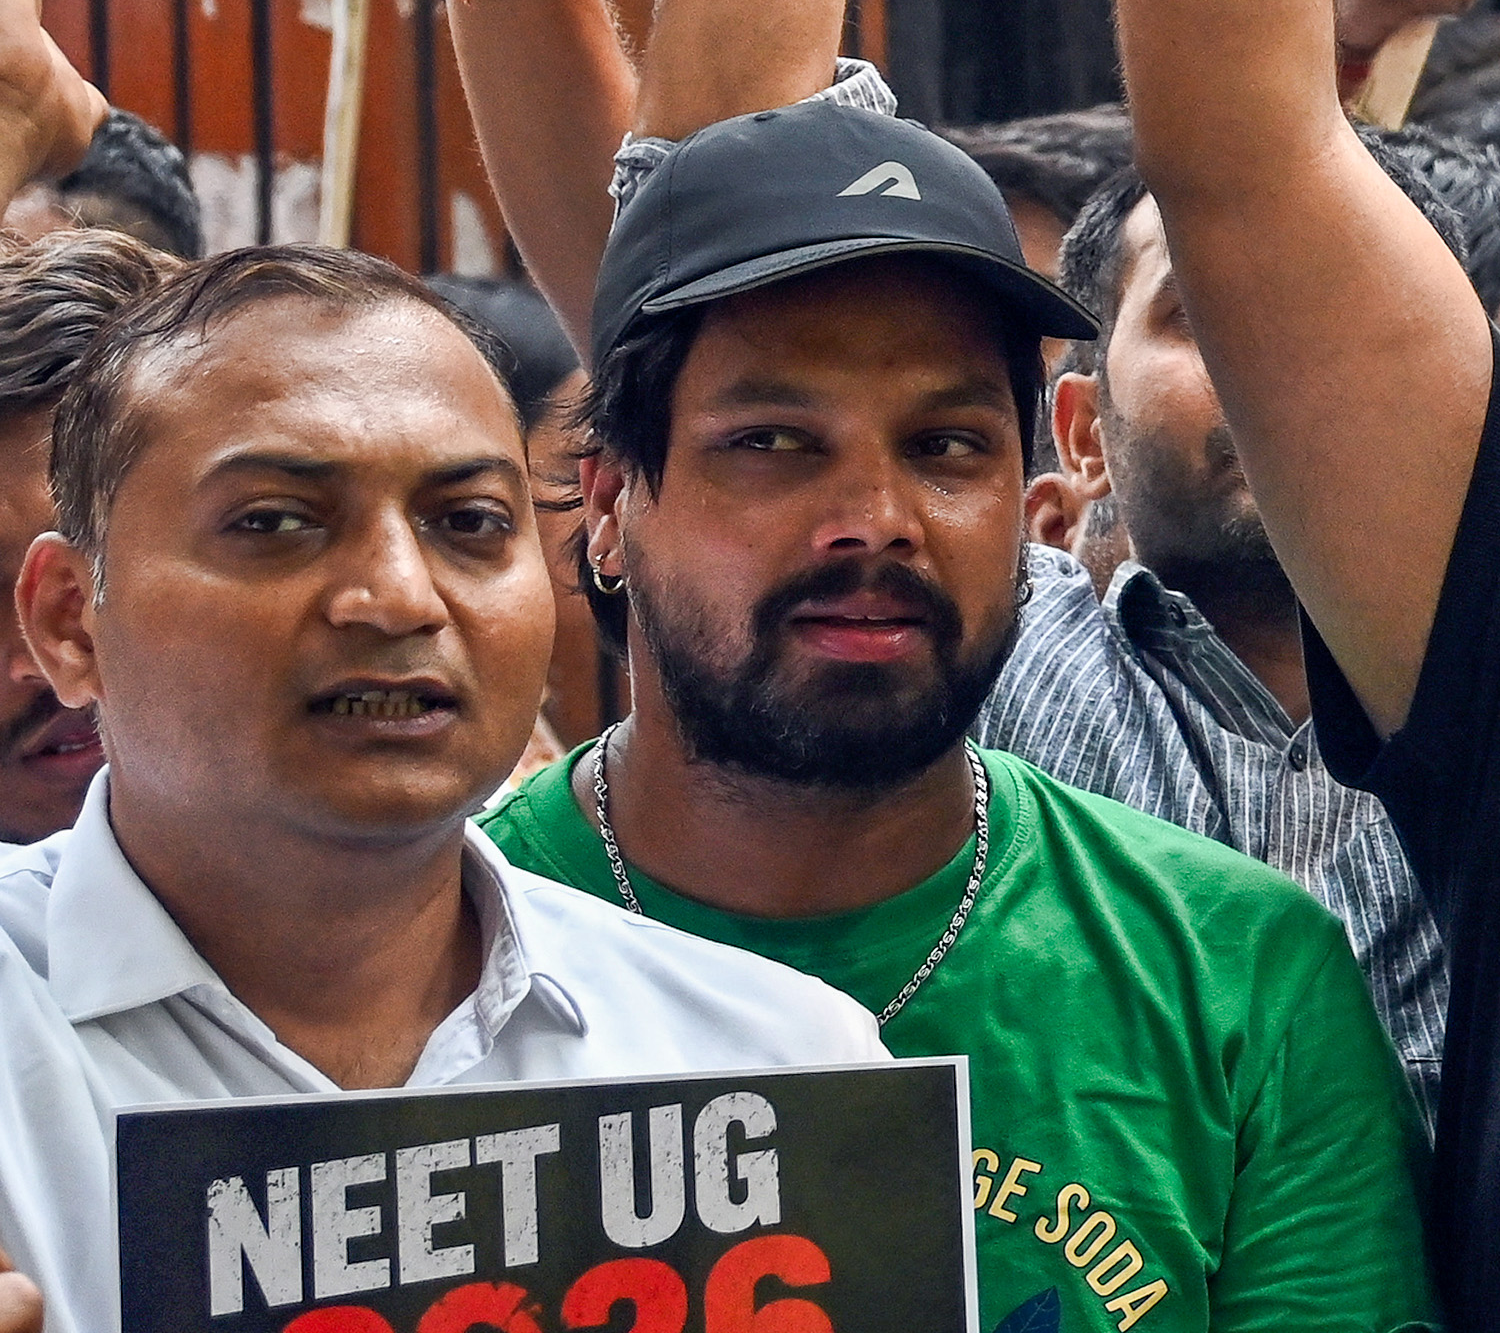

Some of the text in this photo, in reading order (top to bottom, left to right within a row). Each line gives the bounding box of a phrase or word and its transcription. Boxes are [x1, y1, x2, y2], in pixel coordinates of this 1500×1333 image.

[208, 1123, 560, 1316] NEET
[600, 1090, 779, 1248] UG
[971, 1148, 1168, 1333] GE SODA
